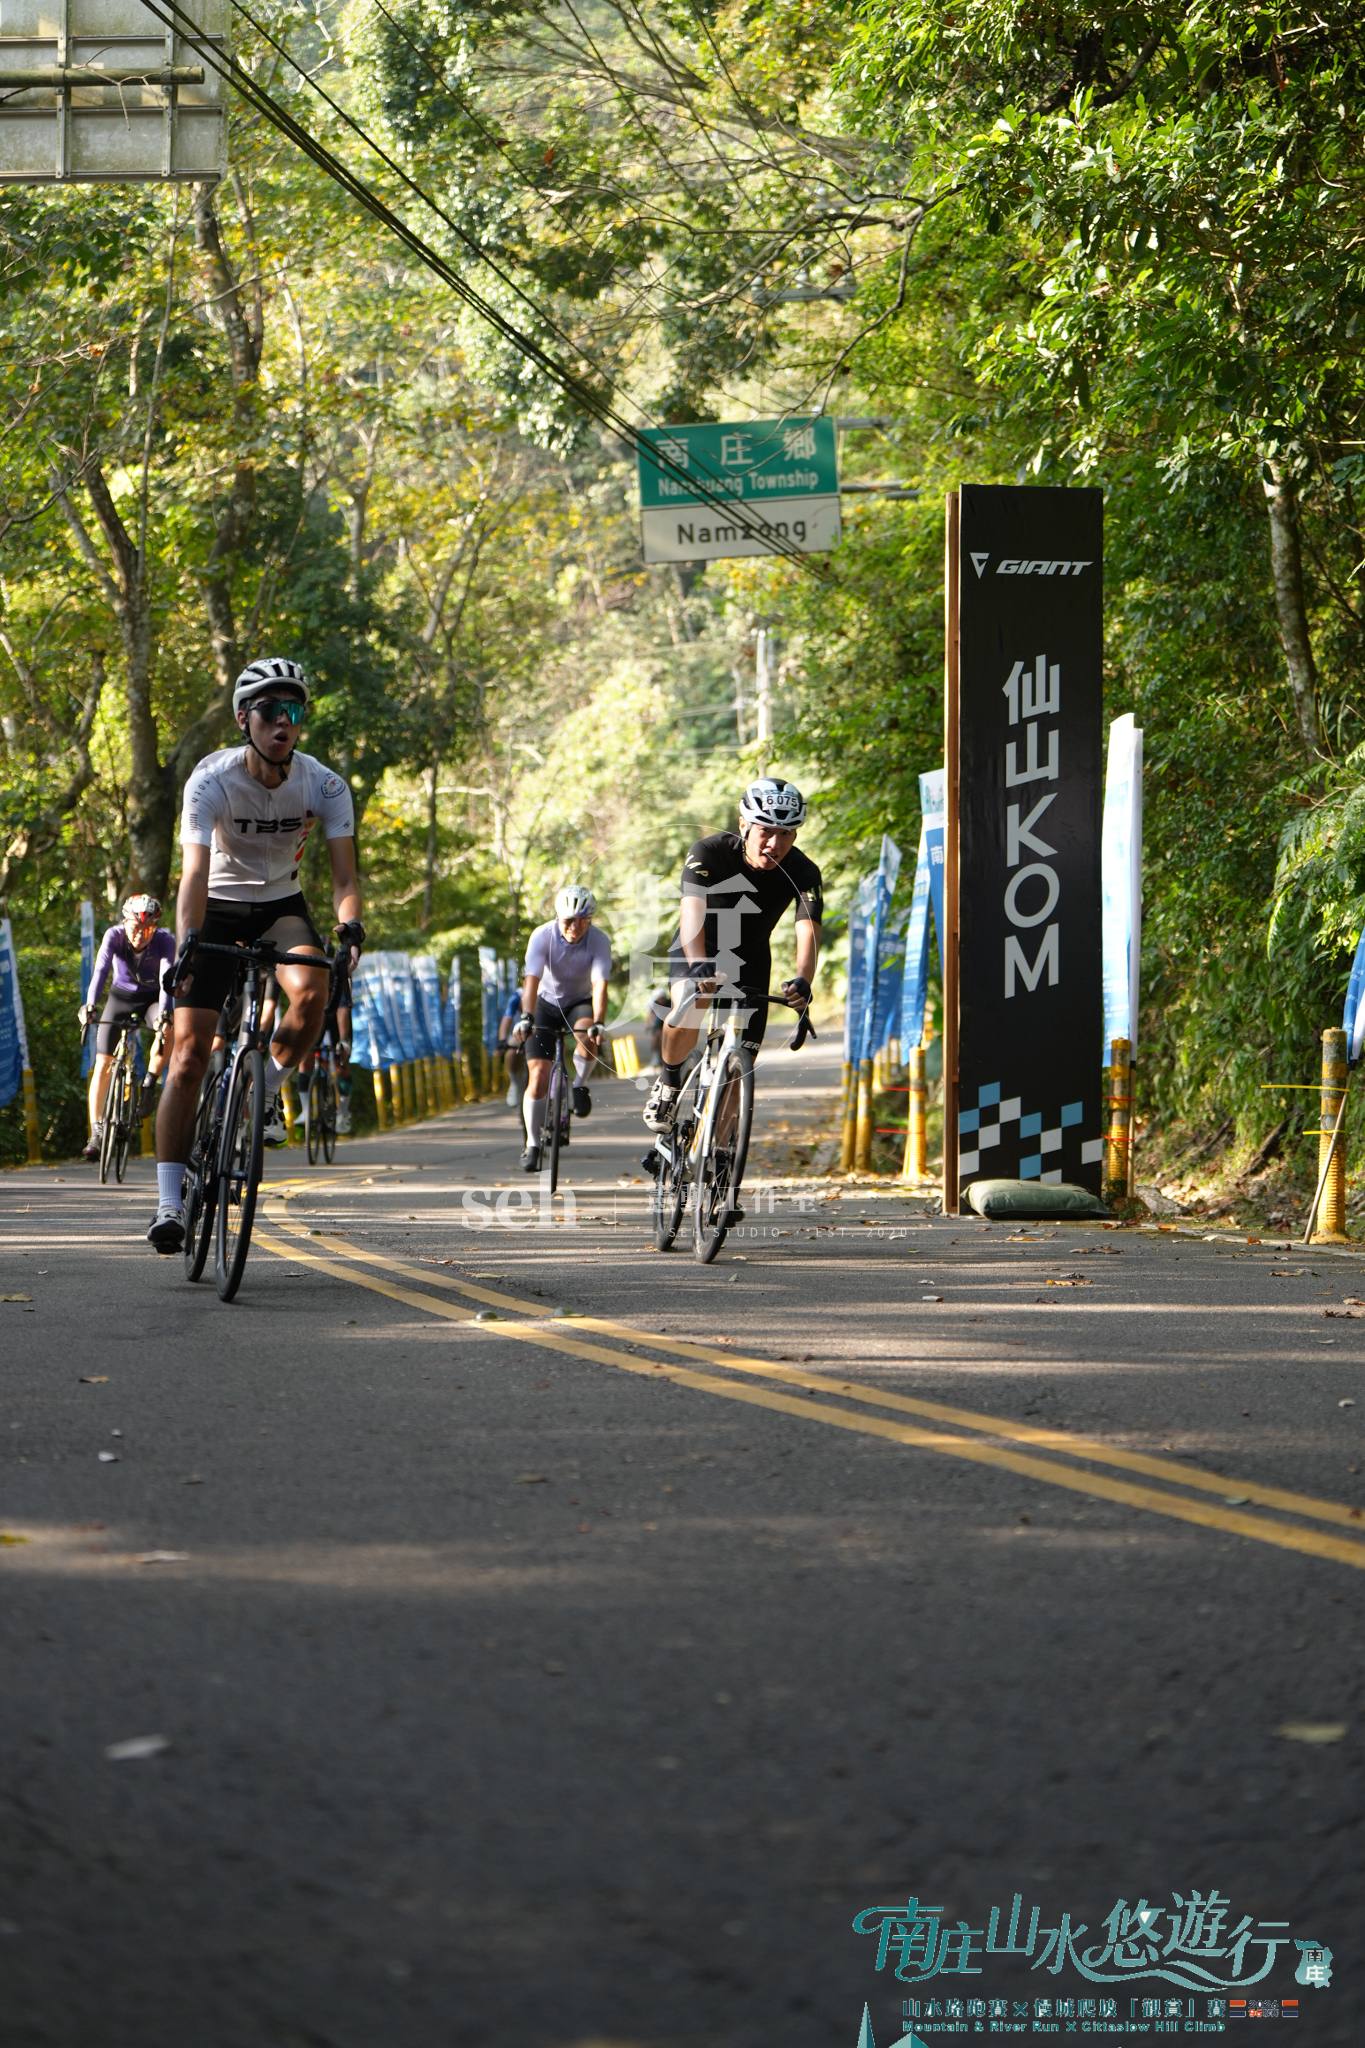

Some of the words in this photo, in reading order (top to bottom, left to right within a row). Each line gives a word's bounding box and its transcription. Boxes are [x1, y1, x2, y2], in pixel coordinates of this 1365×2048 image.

[748, 468, 818, 490] Township
[996, 560, 1094, 576] GIANT
[234, 816, 302, 834] TBS
